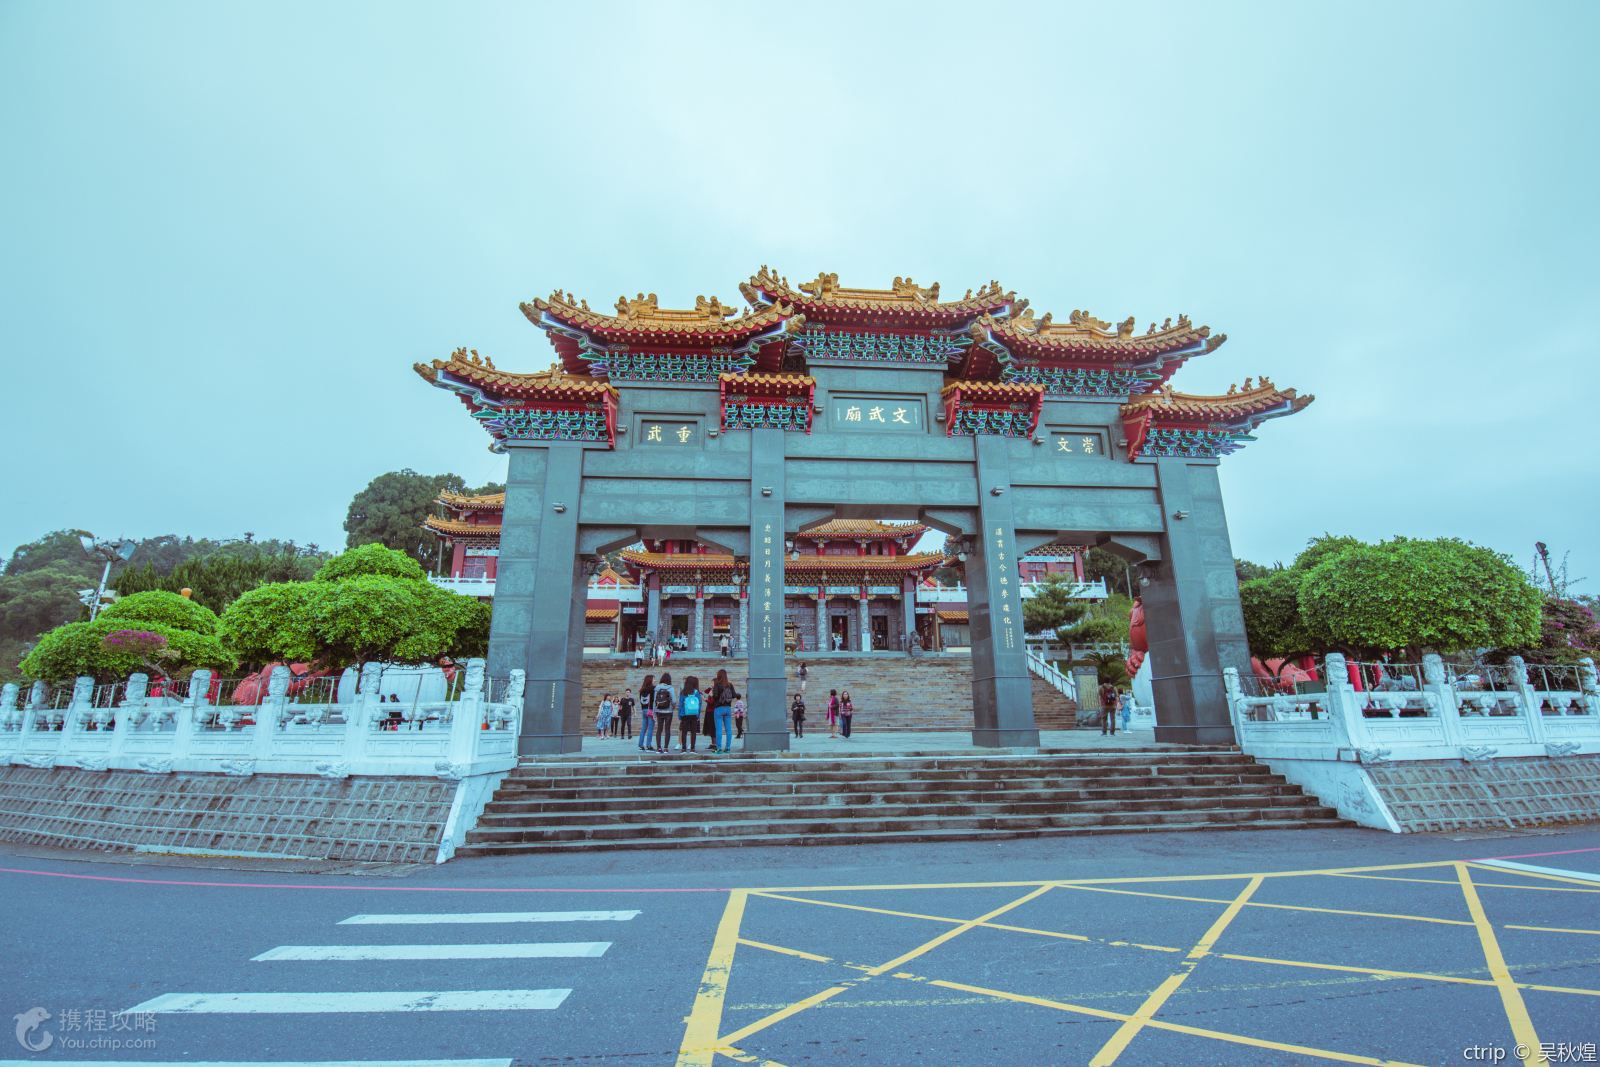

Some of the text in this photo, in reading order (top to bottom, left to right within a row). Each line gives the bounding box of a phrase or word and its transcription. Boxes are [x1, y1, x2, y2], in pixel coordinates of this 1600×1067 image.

[845, 406, 911, 424] 文武廟
[647, 425, 693, 443] 重武
[1057, 436, 1095, 454] 崇文
